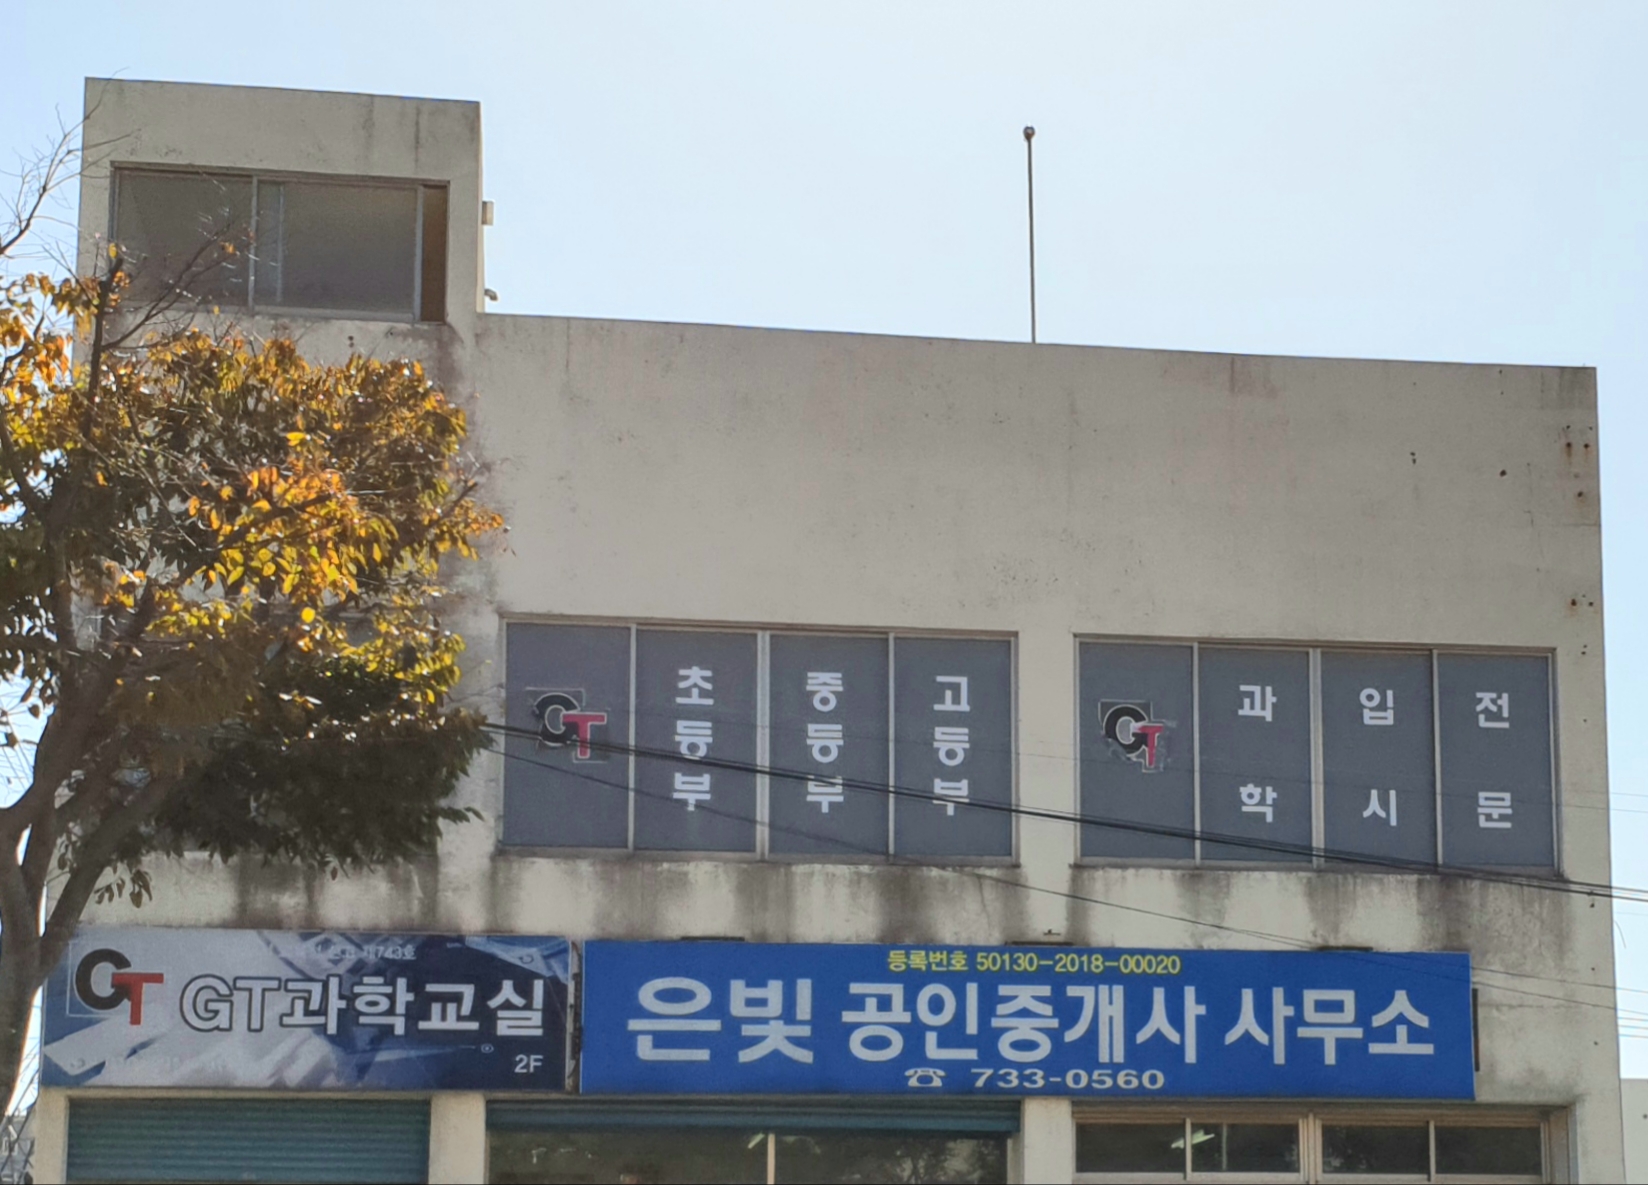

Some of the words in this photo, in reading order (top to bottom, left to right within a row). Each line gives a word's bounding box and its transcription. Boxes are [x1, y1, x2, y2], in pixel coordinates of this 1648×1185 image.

[673, 666, 715, 811] 초등부
[806, 671, 844, 813] 중등부
[932, 675, 970, 816] 고등부
[1238, 684, 1278, 822] 과학
[1359, 687, 1398, 825] 입시
[1475, 692, 1513, 828] 전문
[179, 973, 544, 1037] GT과학교실
[627, 976, 814, 1064] 은빛
[841, 981, 1207, 1064] 공인중개사
[1224, 986, 1435, 1066] 사무소
[887, 950, 968, 972] 등록번호
[976, 953, 1182, 974] 50130-2018-00020
[513, 1054, 544, 1074] 2F
[970, 1068, 1165, 1090] 733-0560
